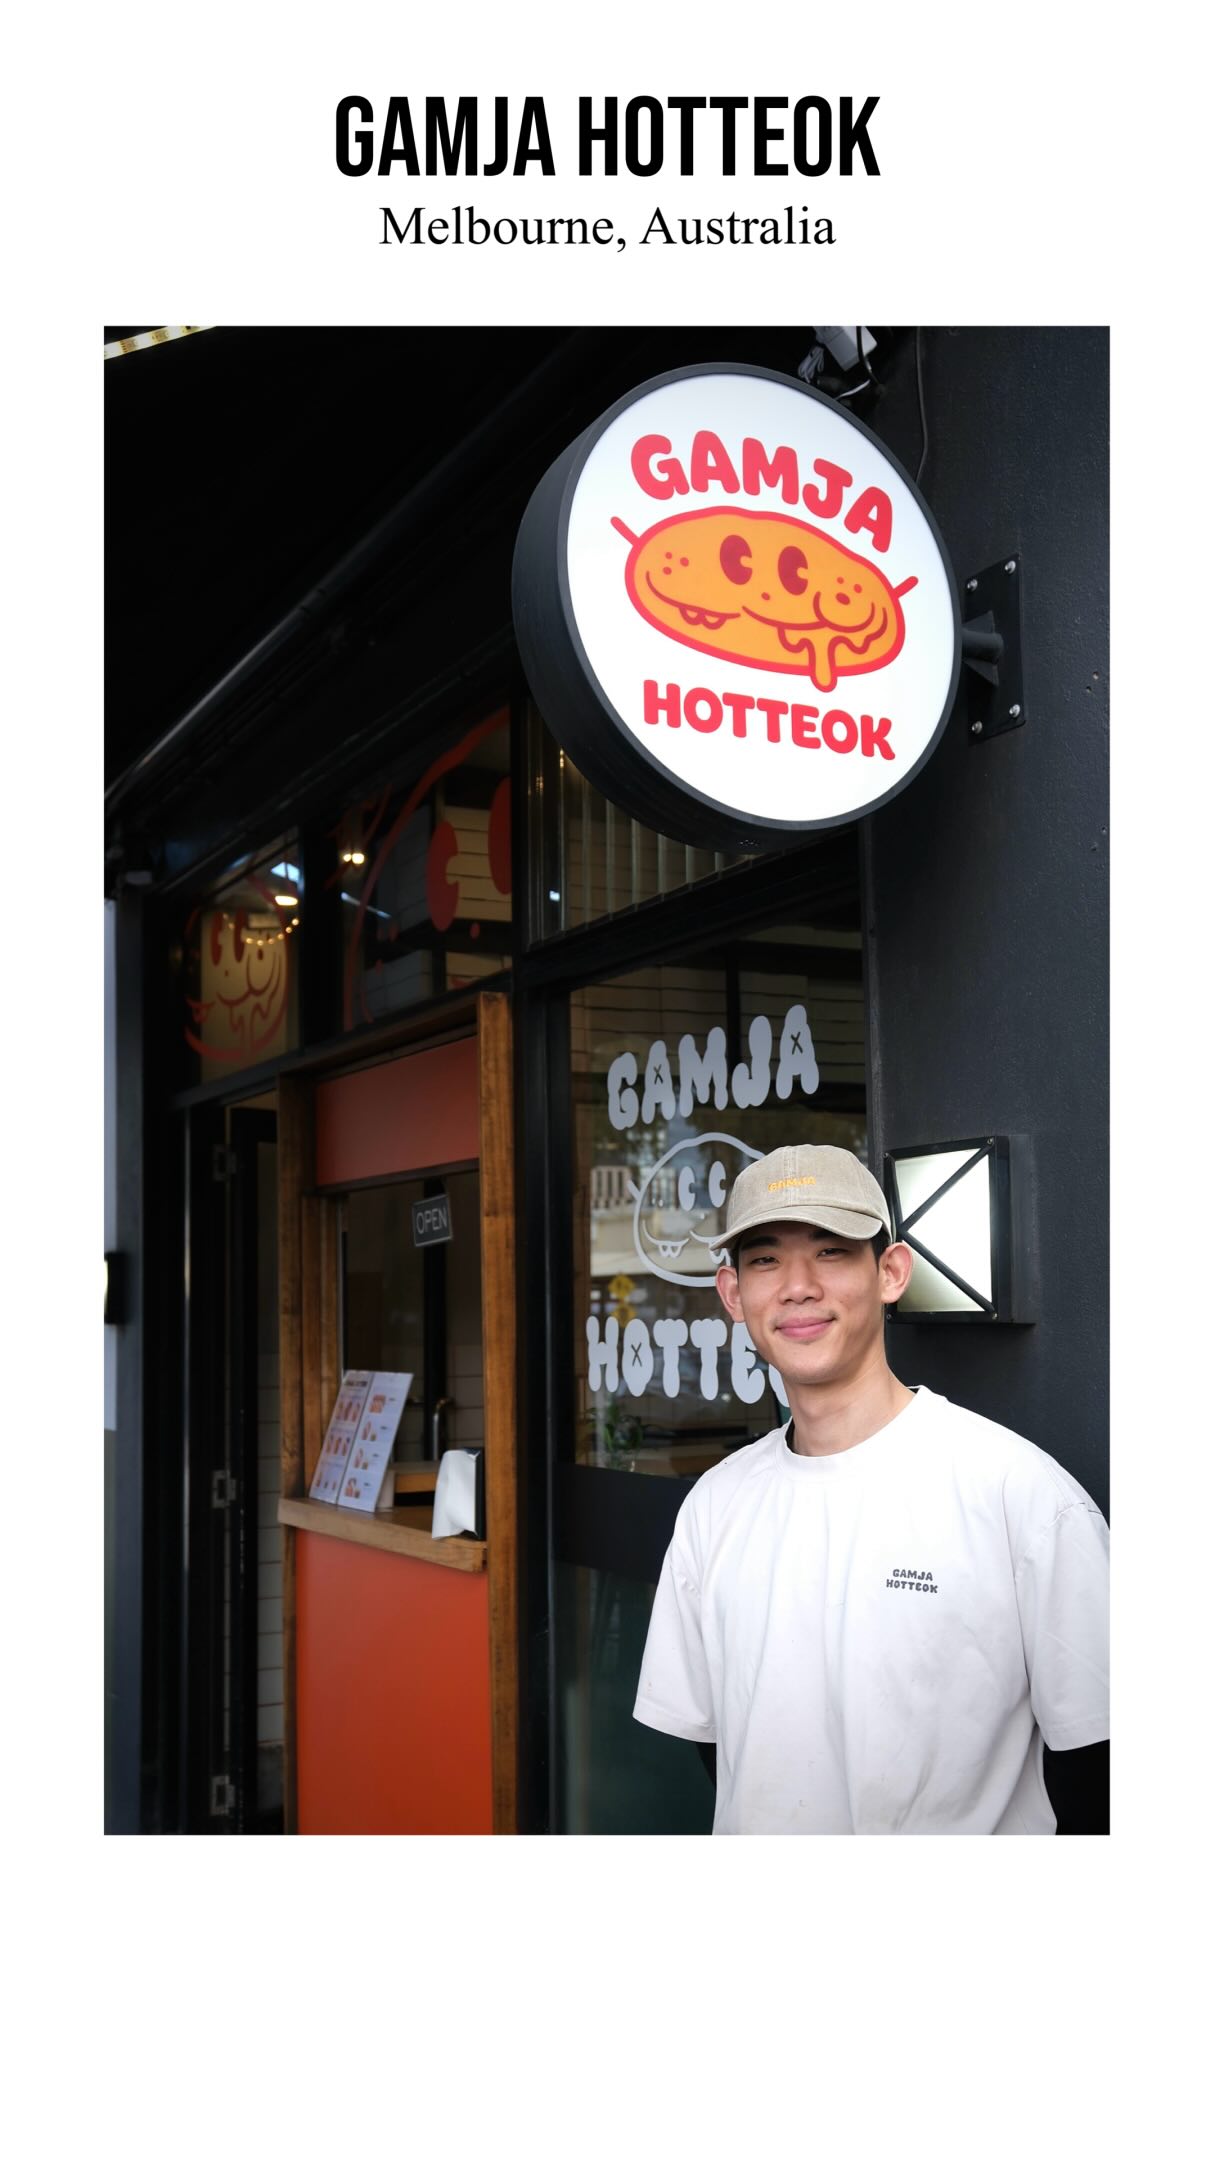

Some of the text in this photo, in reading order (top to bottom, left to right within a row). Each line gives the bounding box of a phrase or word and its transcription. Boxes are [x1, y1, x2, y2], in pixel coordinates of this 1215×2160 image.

[631, 431, 893, 553] GAMJA
[644, 680, 896, 761] HOTTEOK
[607, 1004, 820, 1131] GAMJA
[416, 1206, 448, 1234] OPEN
[886, 1579, 938, 1594] HOTTEOK
[892, 1568, 934, 1581] GAMJA
